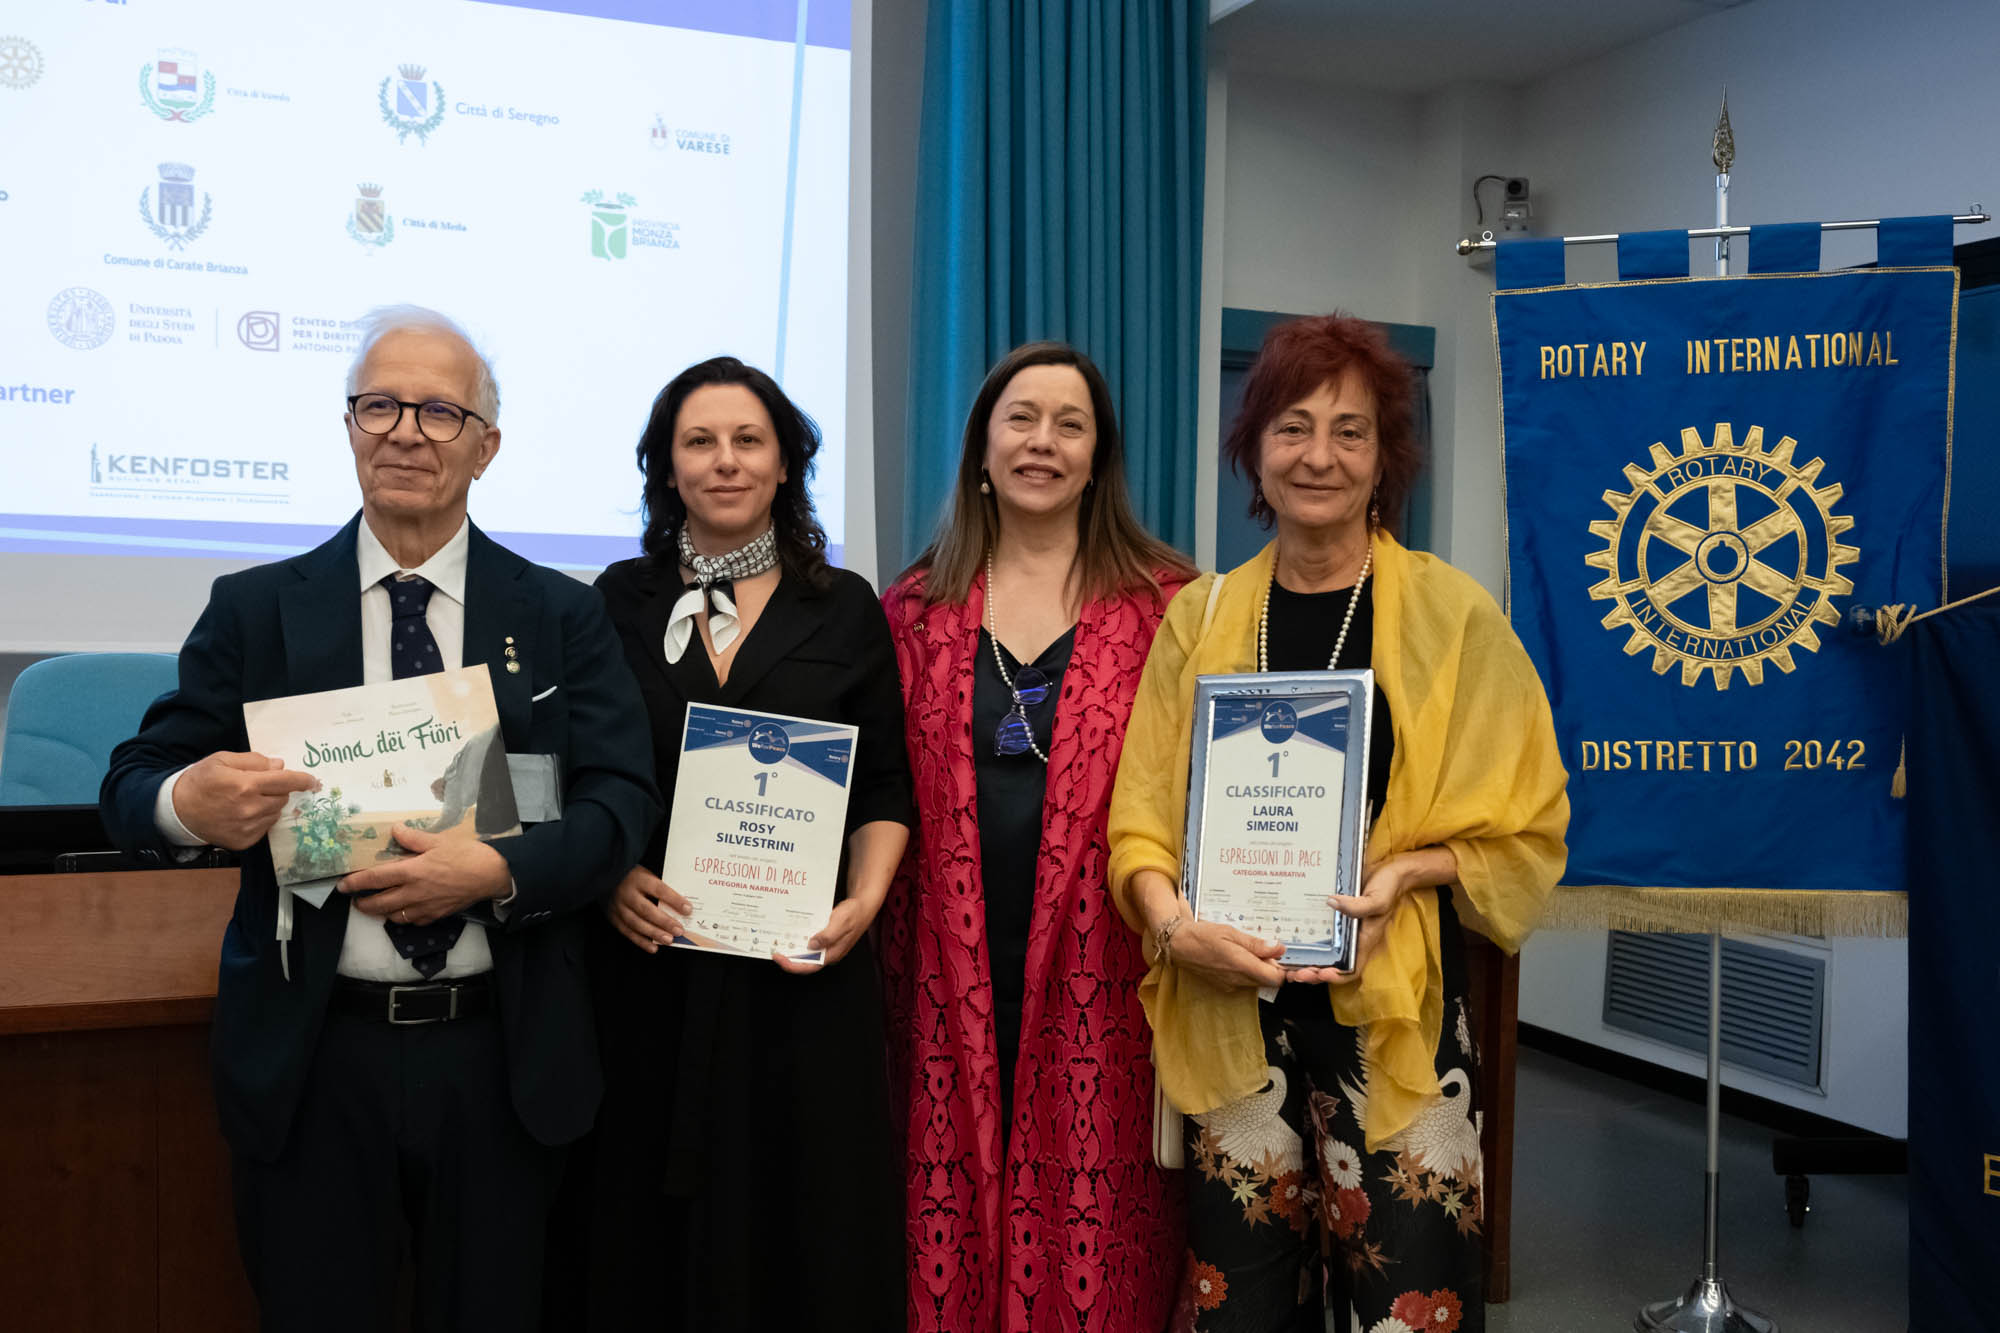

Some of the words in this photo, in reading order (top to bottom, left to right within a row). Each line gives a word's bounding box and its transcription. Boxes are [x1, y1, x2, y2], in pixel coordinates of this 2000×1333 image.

[455, 102, 488, 118] Città
[492, 106, 504, 119] di
[508, 107, 560, 128] Seregno
[676, 138, 730, 155] VARESE
[631, 227, 673, 240] MONZA
[631, 236, 681, 250] BRIANZA
[103, 253, 151, 268] Comune
[153, 258, 164, 269] di
[166, 258, 204, 271] Carate
[206, 261, 249, 275] Brianza
[292, 316, 337, 328] CENTRO
[292, 329, 313, 338] PER
[292, 343, 343, 353] ANTONIO
[1540, 341, 1647, 380] ROTARY
[1686, 331, 1899, 375] INTERNATIONAL
[107, 454, 289, 481] KENFOSTER
[1667, 456, 1773, 488] ROTARY
[1629, 596, 1814, 659] INTERNATIONAL
[302, 739, 374, 768] Dönna
[406, 715, 463, 750] Fiöri
[1581, 740, 1758, 773] DISTRETTO
[1783, 739, 1867, 771] 2042
[1225, 785, 1326, 799] CLASSIFICATO
[704, 796, 815, 823] CLASSIFICATO
[1252, 805, 1294, 817] LAURA
[739, 820, 775, 835] ROSY
[1246, 820, 1299, 833] SIMEONI
[716, 832, 794, 853] SILVESTRINI
[1219, 847, 1279, 866] ESPRESSIONI
[1283, 848, 1294, 866] DI
[1298, 849, 1321, 868] PACE
[694, 856, 760, 881] ESPRESSIONI
[765, 866, 777, 882] DI
[782, 868, 808, 887] PACE
[1232, 868, 1269, 878] CATEGORIA
[1269, 870, 1306, 879] NARRATIVA
[708, 879, 748, 890] CATEGORIA
[749, 884, 790, 896] NARRATIVA
